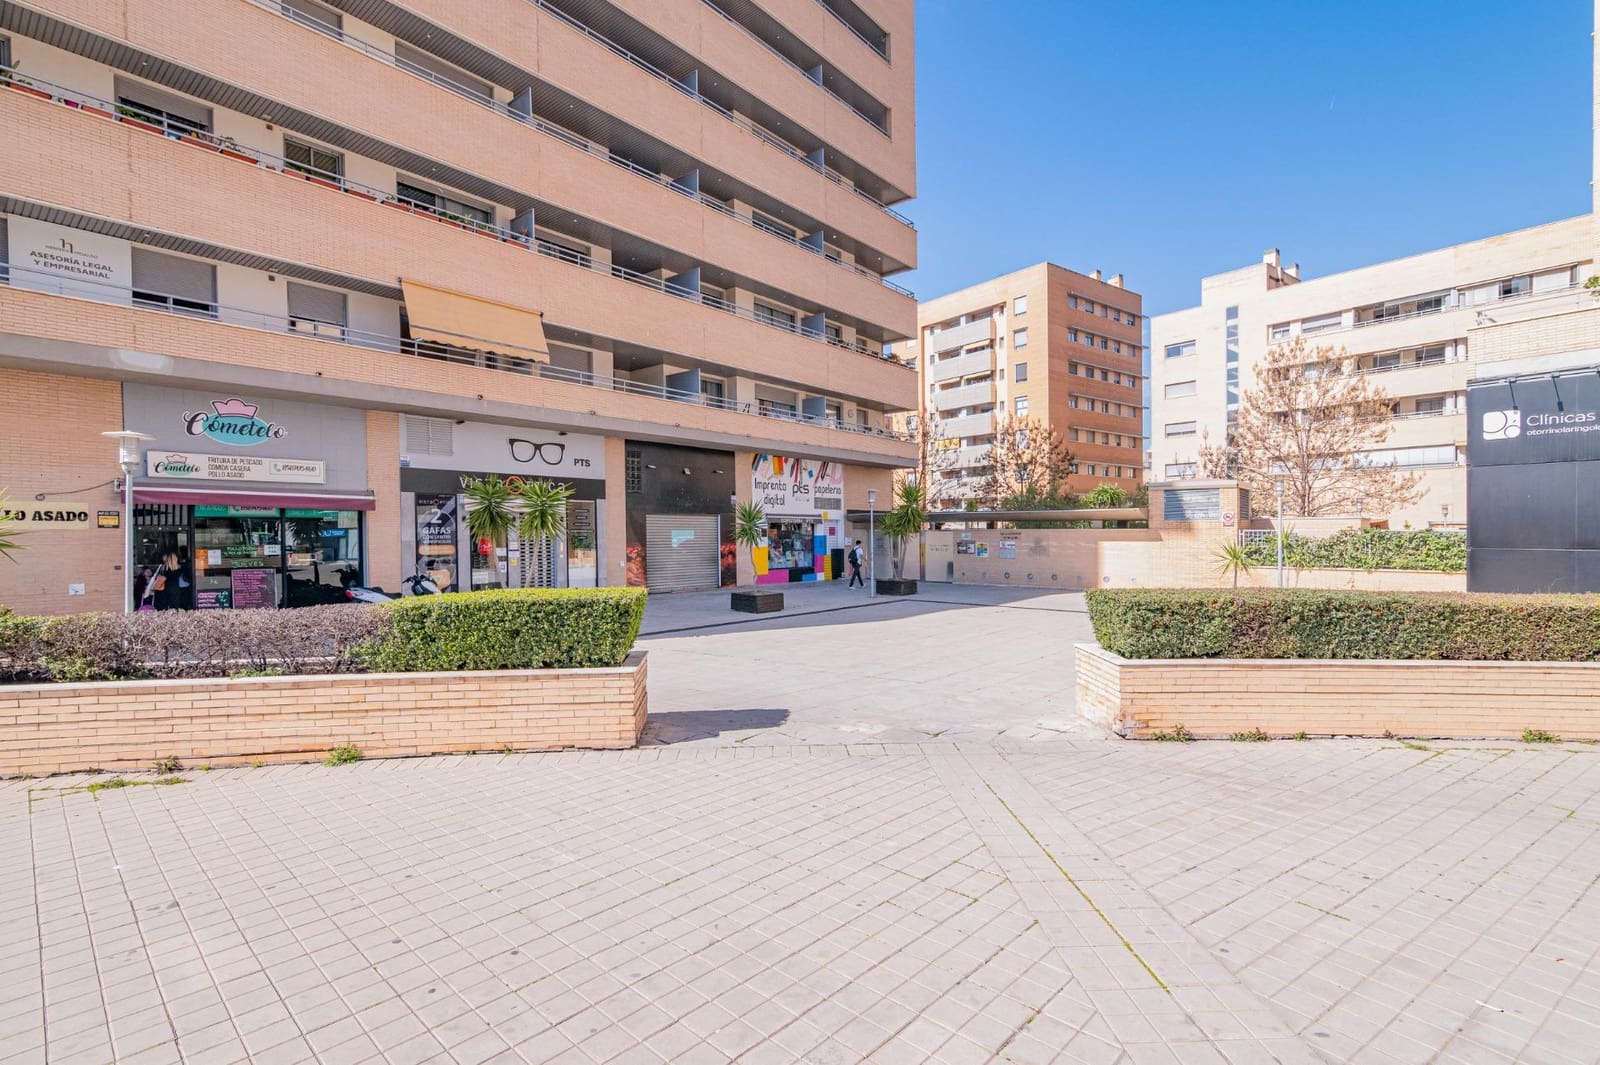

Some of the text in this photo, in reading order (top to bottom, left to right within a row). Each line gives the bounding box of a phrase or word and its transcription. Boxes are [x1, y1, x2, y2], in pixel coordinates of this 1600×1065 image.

[43, 261, 111, 280] EMPRESARIAL
[82, 260, 114, 273] LEGAL
[183, 411, 285, 439] Cómetelo
[1526, 412, 1597, 427] Clínicas
[207, 456, 231, 465] FRITURA
[240, 458, 263, 466] PESCADO
[573, 458, 591, 468] PTS
[226, 471, 245, 479] ASADO
[754, 478, 787, 494] Imprenta
[792, 481, 810, 497] pts
[763, 494, 785, 509] digital
[31, 510, 89, 522] ASADO
[430, 508, 442, 524] 2
[422, 526, 451, 535] GAFAS
